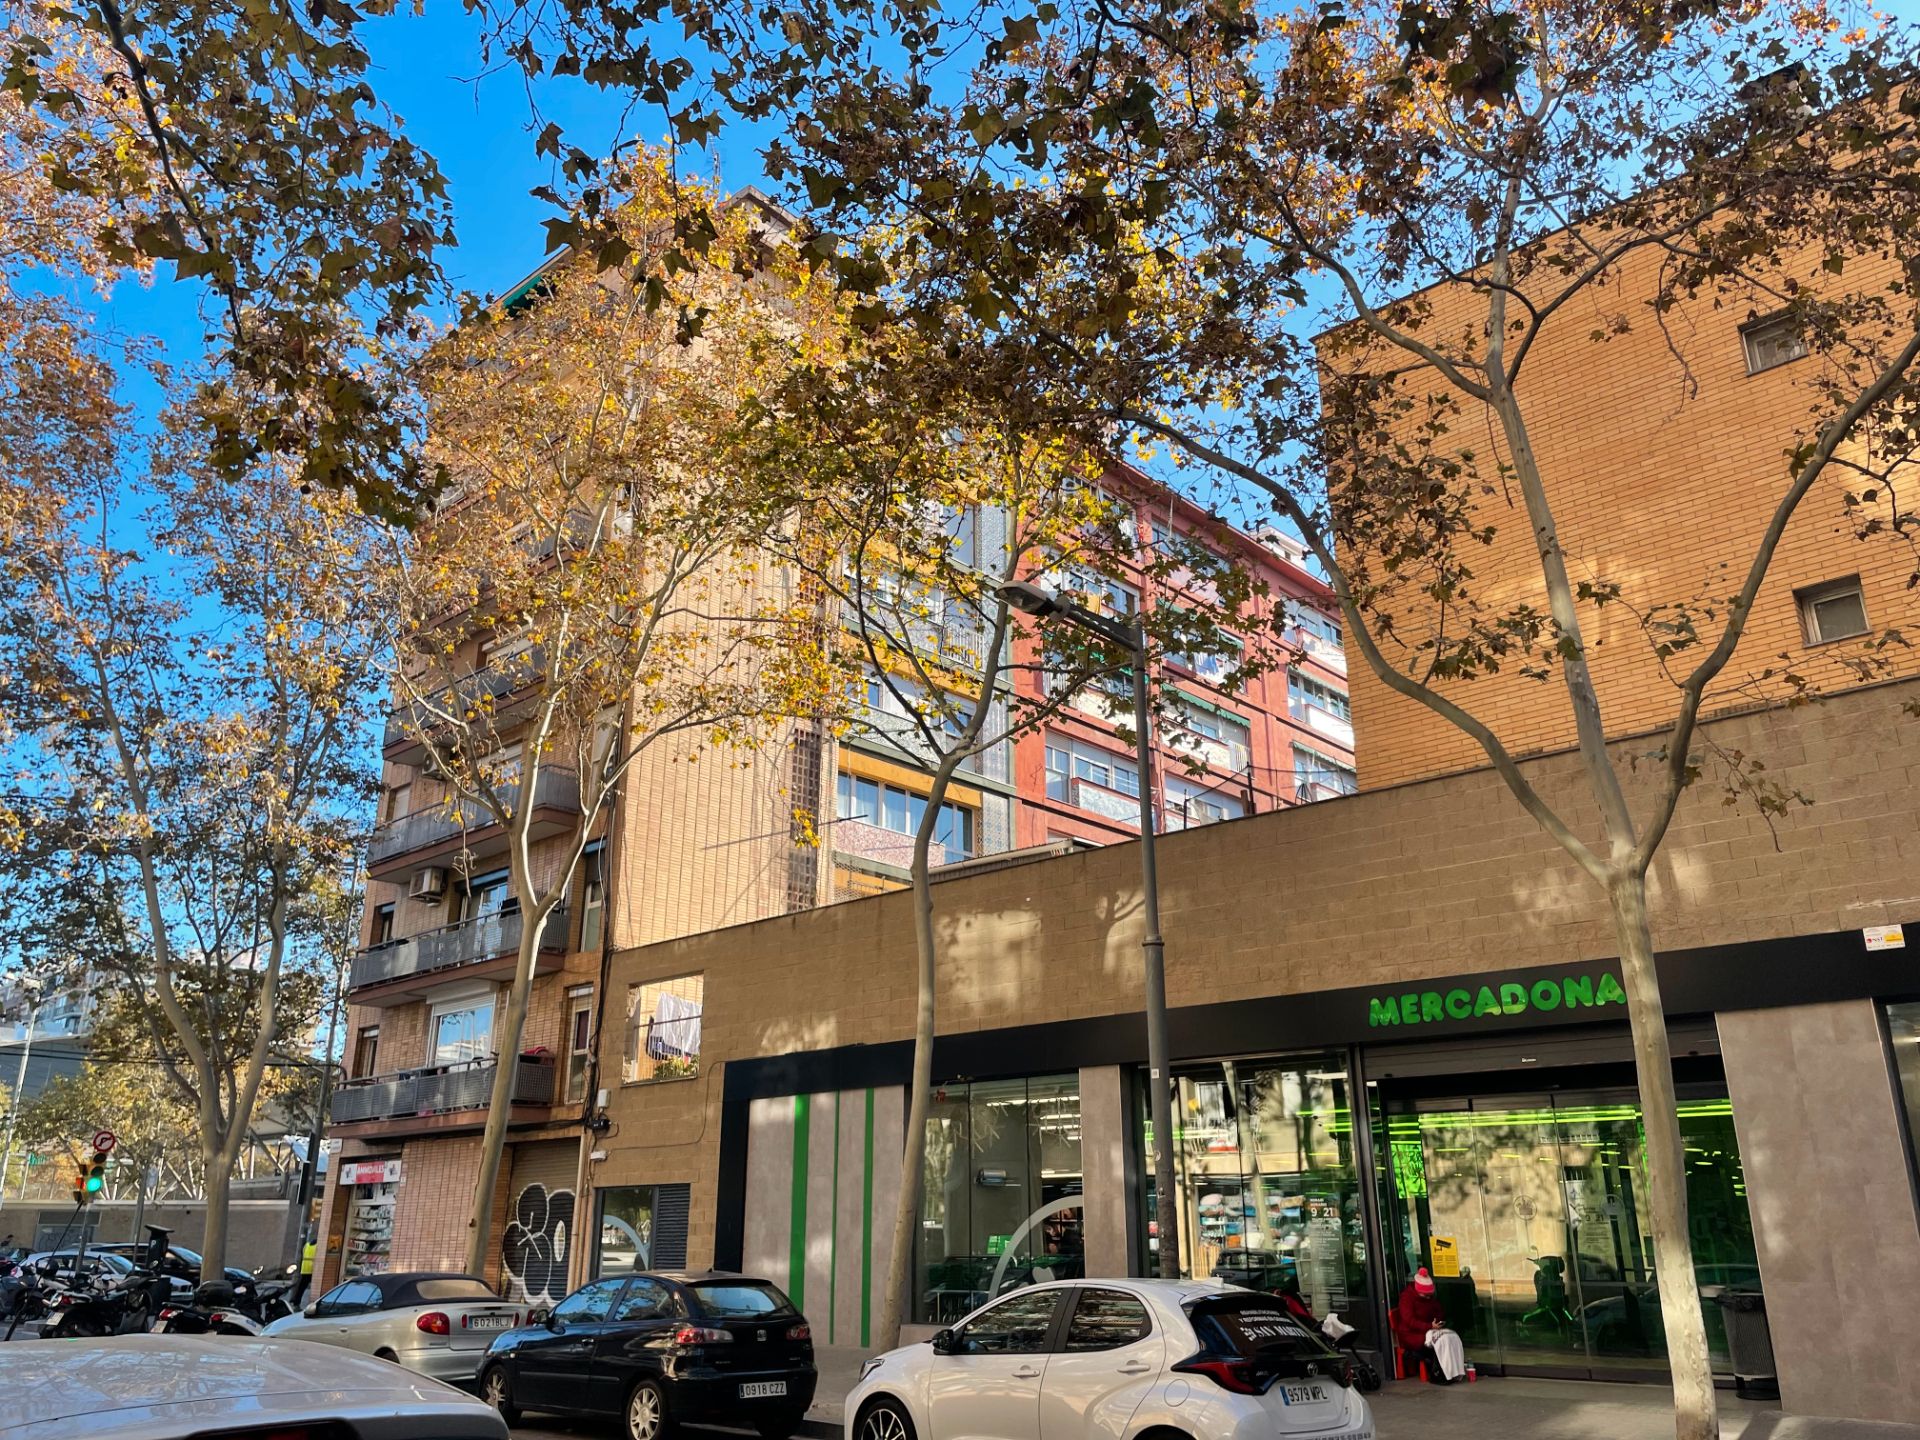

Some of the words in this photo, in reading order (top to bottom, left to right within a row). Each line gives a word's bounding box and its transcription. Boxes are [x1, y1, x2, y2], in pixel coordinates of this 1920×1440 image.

[1369, 972, 1626, 1027] MERCADONA
[1310, 1207, 1317, 1217] 9
[1323, 1207, 1333, 1217] 21
[745, 1385, 767, 1396] 0918
[769, 1383, 784, 1394] CZZ
[1287, 1387, 1310, 1402] 9579
